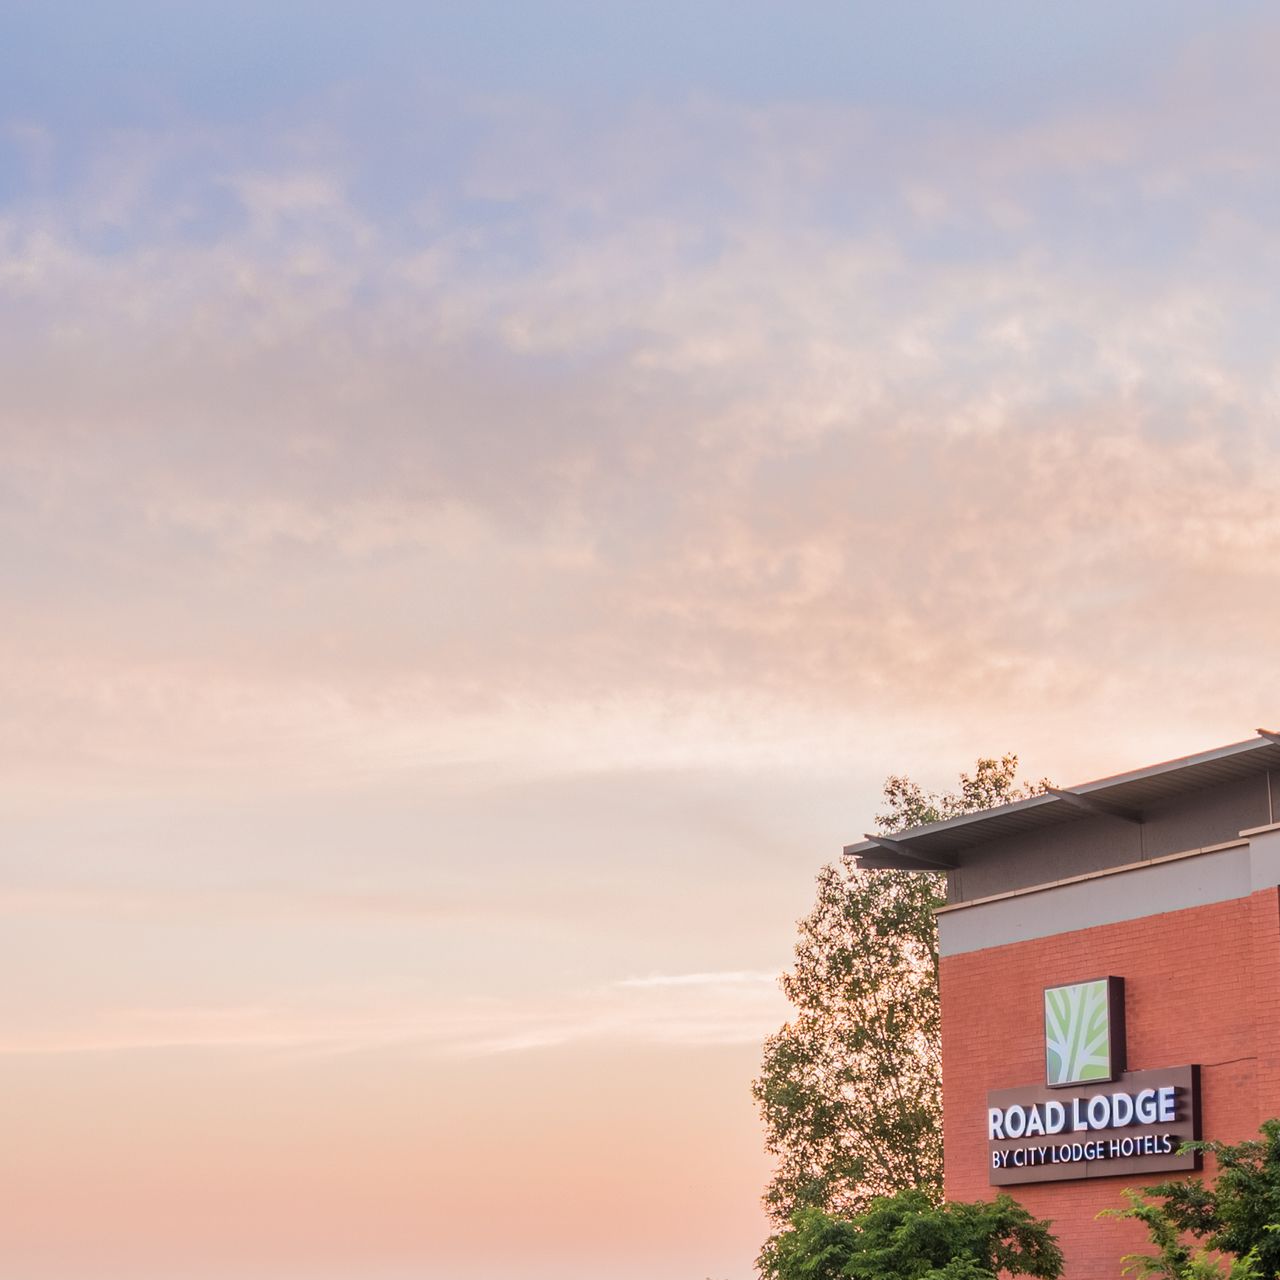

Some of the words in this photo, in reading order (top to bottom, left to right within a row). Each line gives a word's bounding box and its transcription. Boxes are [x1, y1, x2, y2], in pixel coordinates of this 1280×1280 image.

[988, 1101, 1066, 1140] ROAD
[1073, 1086, 1175, 1131] LODGE
[992, 1150, 1010, 1169] BY
[1014, 1146, 1047, 1167] CITY
[1052, 1140, 1104, 1164] LODGE
[1110, 1134, 1172, 1158] HOTELS
